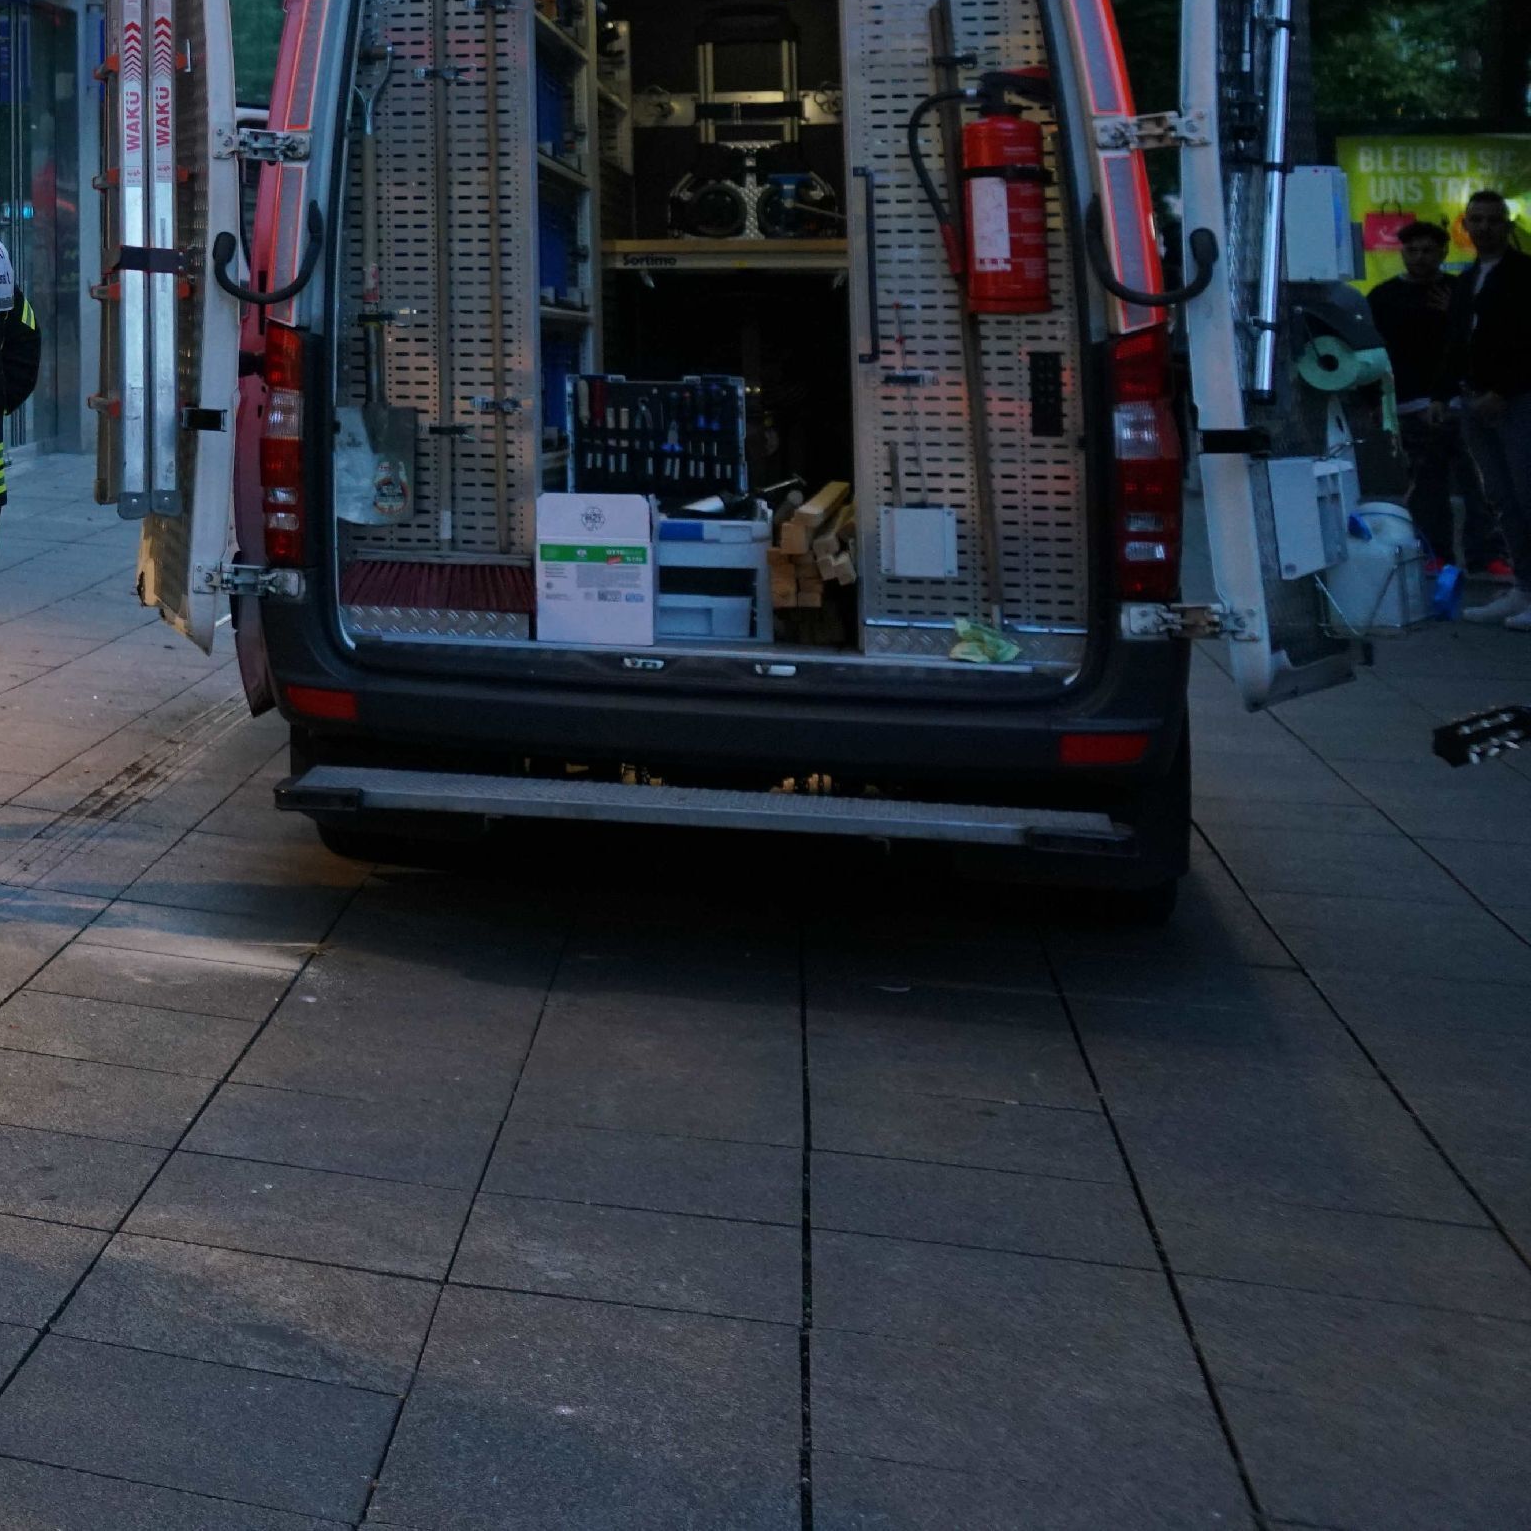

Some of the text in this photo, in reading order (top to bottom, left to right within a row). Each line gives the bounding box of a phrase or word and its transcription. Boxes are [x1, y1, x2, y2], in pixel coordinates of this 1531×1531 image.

[127, 91, 140, 151] WAKÜ
[156, 86, 170, 147] WAKÜ
[1358, 146, 1468, 174] BLEIBEN
[1370, 177, 1423, 204] UNS
[623, 254, 677, 267] Sortimo
